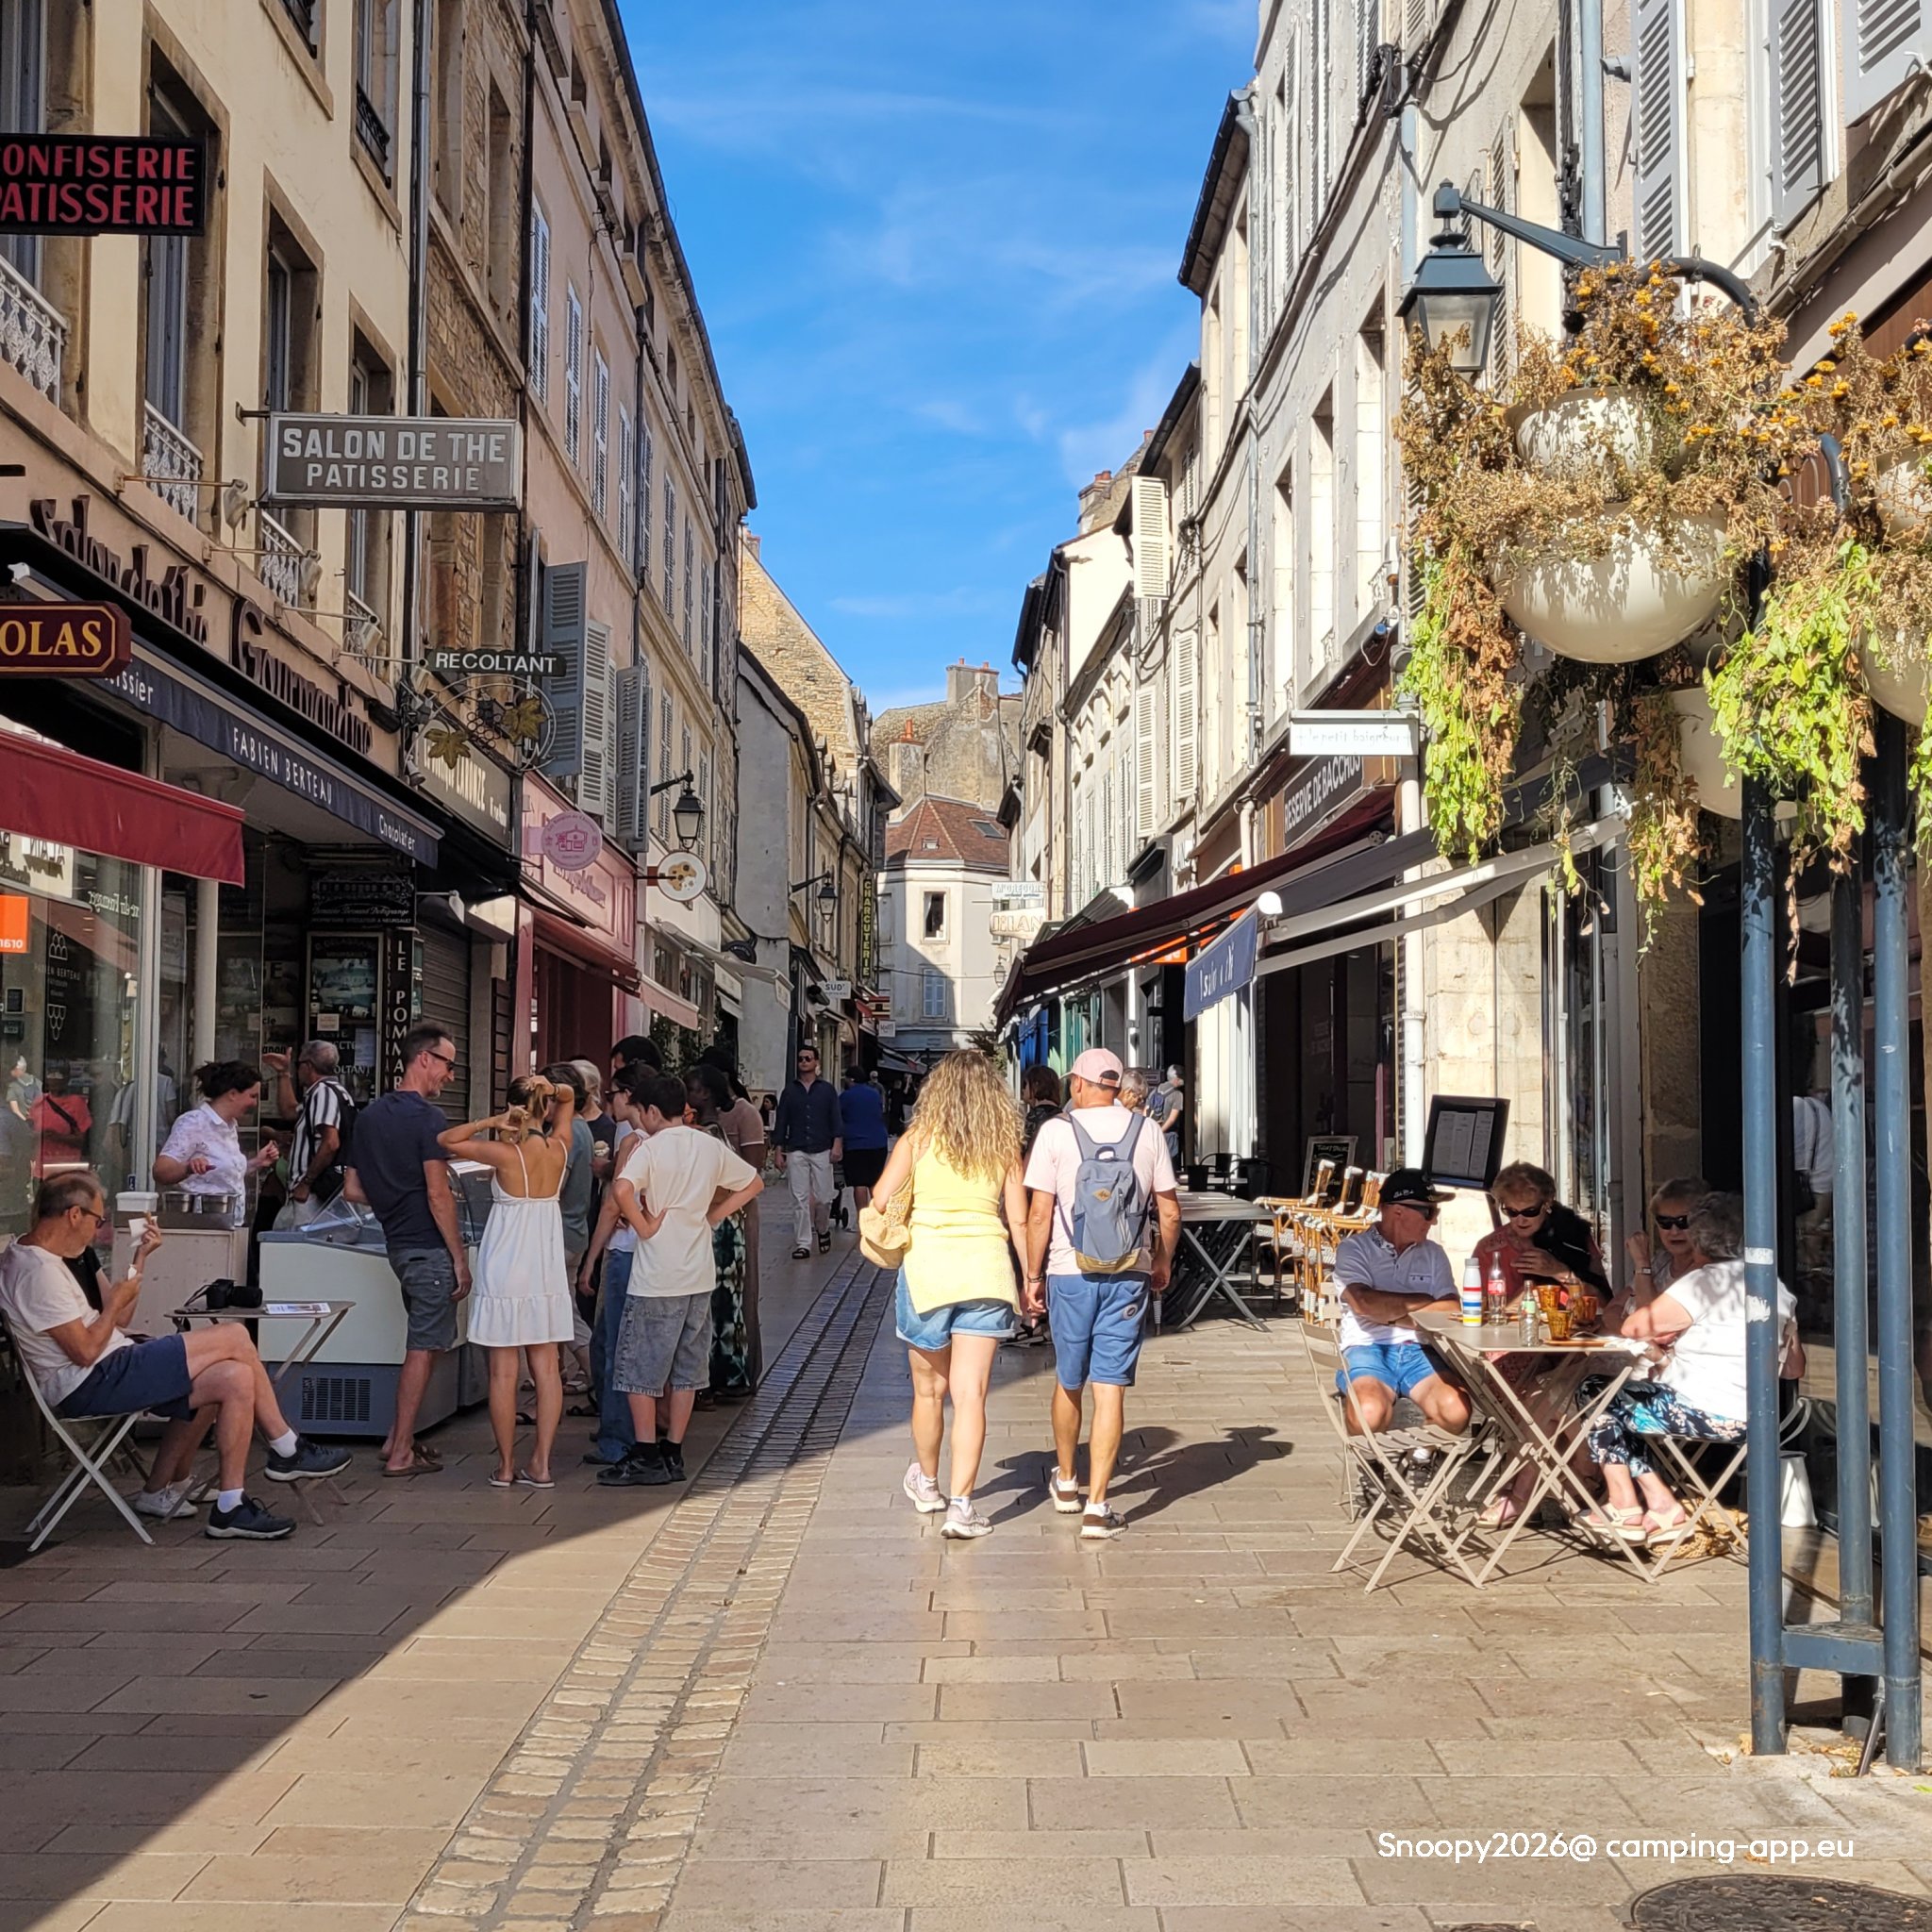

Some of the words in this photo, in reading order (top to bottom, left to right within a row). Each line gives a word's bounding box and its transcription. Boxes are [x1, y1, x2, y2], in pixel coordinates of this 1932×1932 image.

[0, 143, 194, 179] ONFISERIE
[0, 182, 194, 226] ATISSERIE
[283, 427, 385, 461] SALON
[397, 430, 436, 462] DE
[446, 432, 507, 463] THE
[307, 465, 480, 491] PATISSERIE
[0, 620, 101, 657] OLAS
[436, 652, 557, 674] RECOLTANT
[233, 727, 278, 775] FABIEN
[285, 758, 332, 805] BERTEAU
[1285, 780, 1312, 834] RESERVE
[1313, 771, 1322, 808] DE
[1322, 755, 1360, 799] BACCHUS
[379, 814, 416, 852] Chocolatier
[863, 881, 872, 976] CHARCUTERIE
[397, 941, 407, 972] LE
[391, 991, 408, 1090] POMMAR
